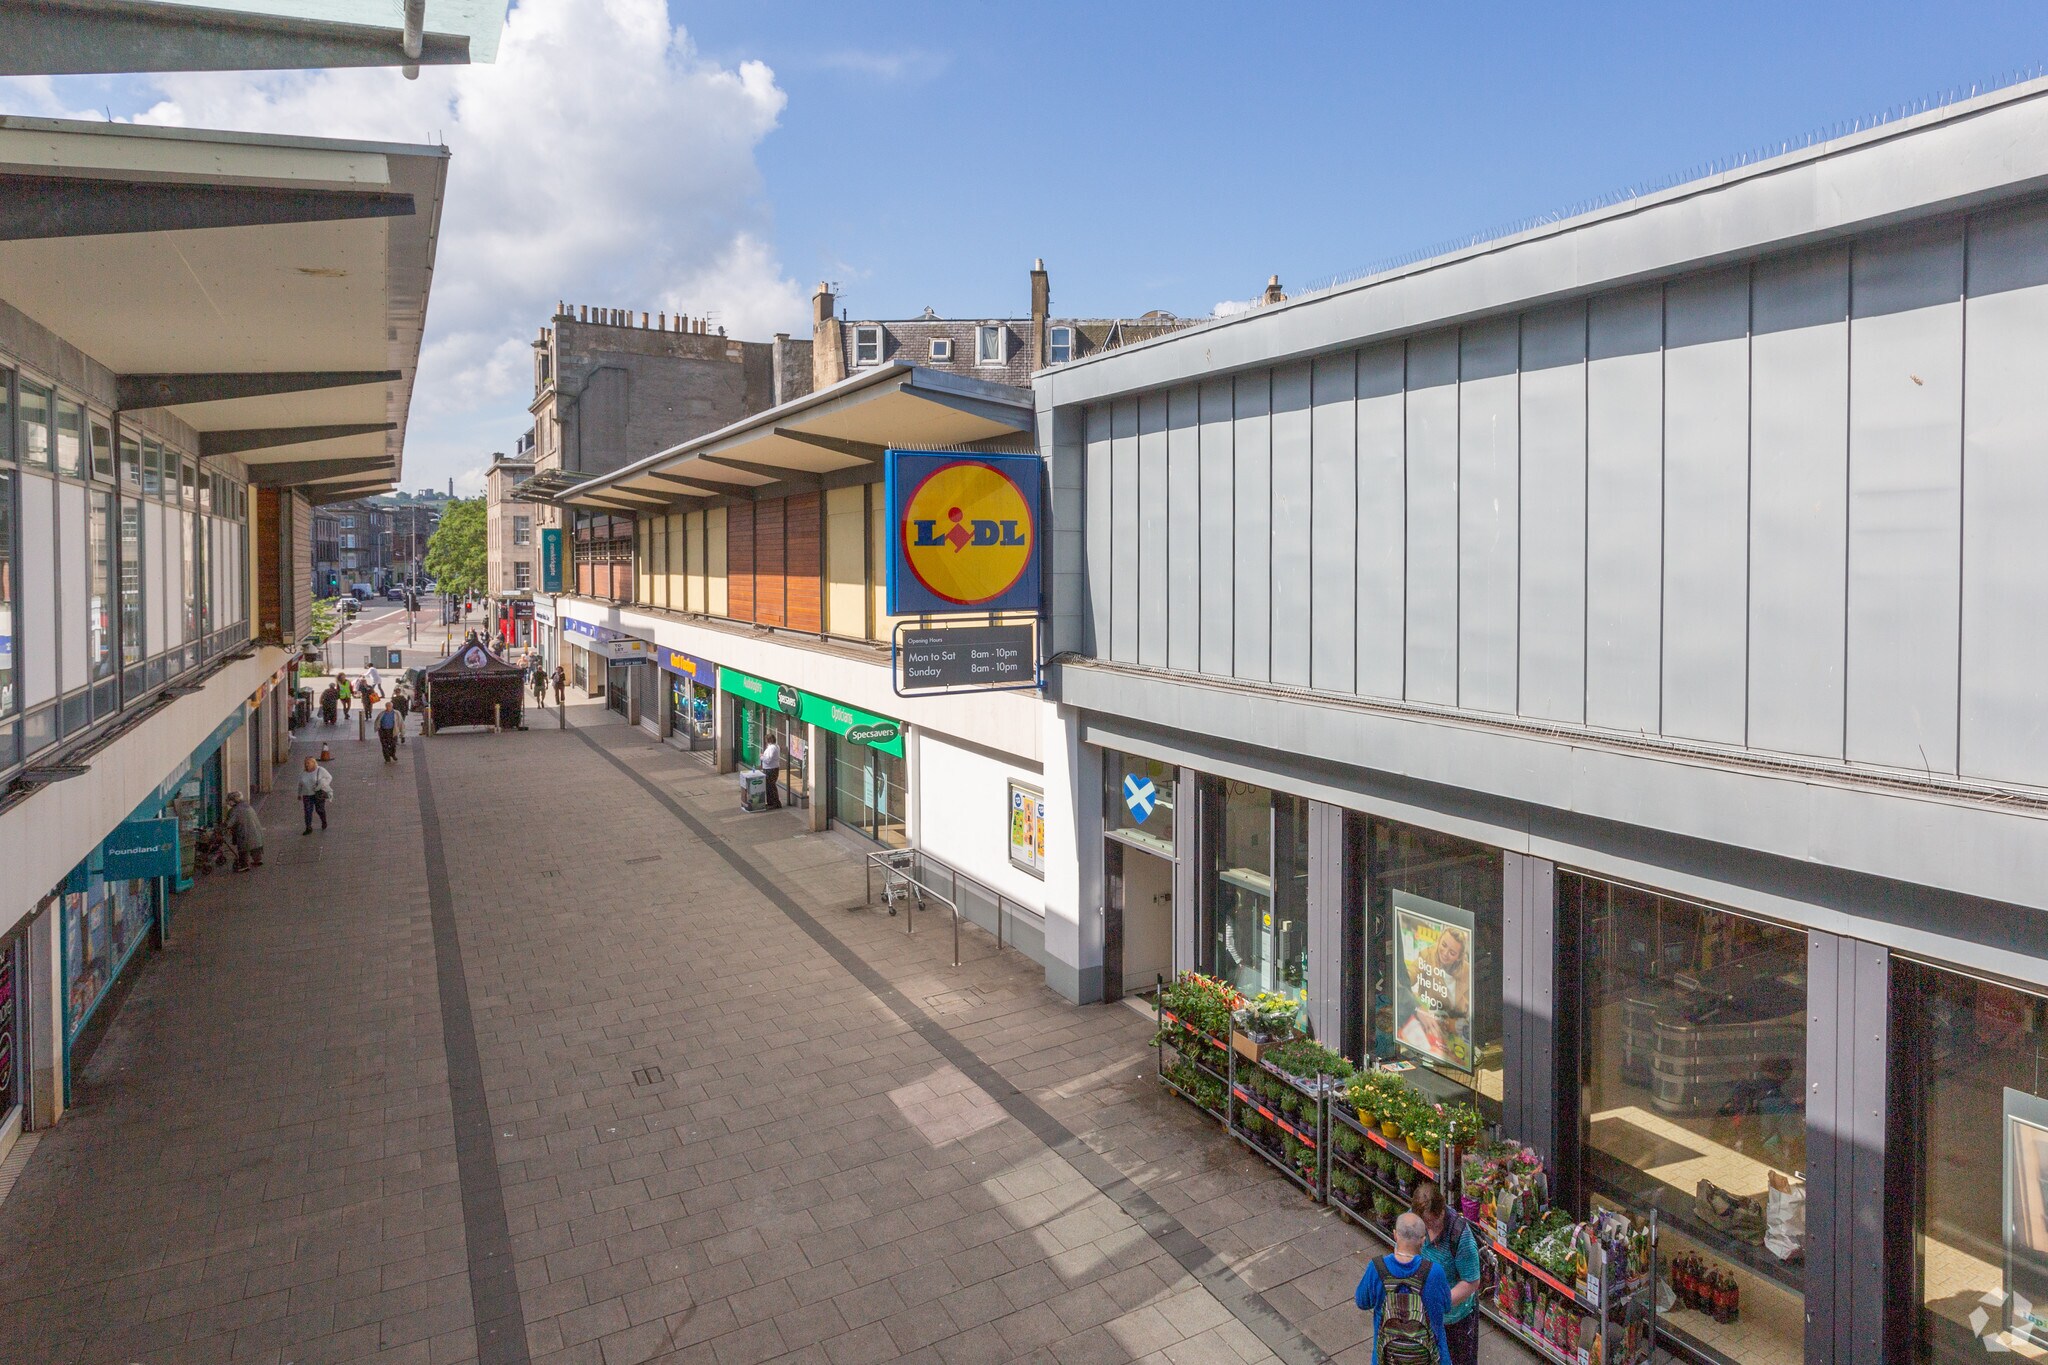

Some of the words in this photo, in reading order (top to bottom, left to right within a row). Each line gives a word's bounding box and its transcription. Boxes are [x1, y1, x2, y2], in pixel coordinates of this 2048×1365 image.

[908, 652, 929, 662] Mon
[930, 652, 940, 660] to
[941, 651, 956, 661] Sat
[970, 649, 990, 659] 8am
[995, 648, 1018, 659] 10pm
[908, 666, 942, 678] Sunday
[971, 663, 990, 673] 8am
[996, 662, 1018, 673] 10pm
[778, 692, 796, 707] Specsavers
[832, 706, 853, 724] Opticians
[852, 729, 893, 740] Specsavers
[108, 845, 159, 856] Poundland
[1418, 957, 1431, 976] Big
[1434, 965, 1446, 979] on
[1417, 973, 1431, 988] the
[1432, 977, 1448, 998] big
[1420, 991, 1442, 1010] shop
